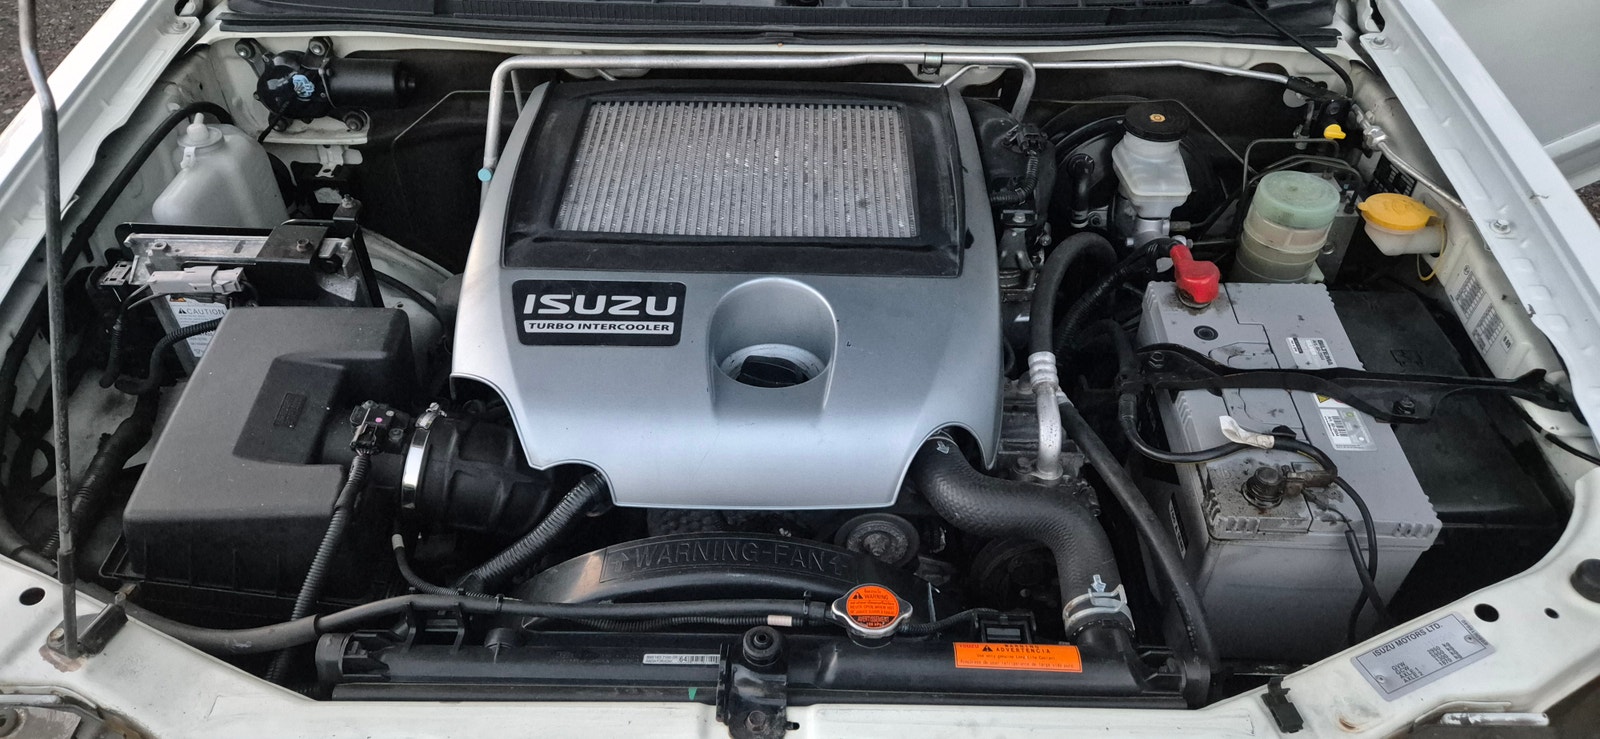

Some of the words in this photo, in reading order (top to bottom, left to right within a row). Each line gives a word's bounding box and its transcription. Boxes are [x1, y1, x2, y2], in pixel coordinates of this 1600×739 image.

[523, 294, 677, 316] ISUZU
[529, 322, 574, 330] TURBO
[578, 323, 670, 331] INTERCOOLER
[1373, 644, 1395, 657] ISUZU
[1395, 630, 1426, 647] MOTORS
[1427, 623, 1442, 633] LTD.
[1403, 673, 1420, 683] AXLE
